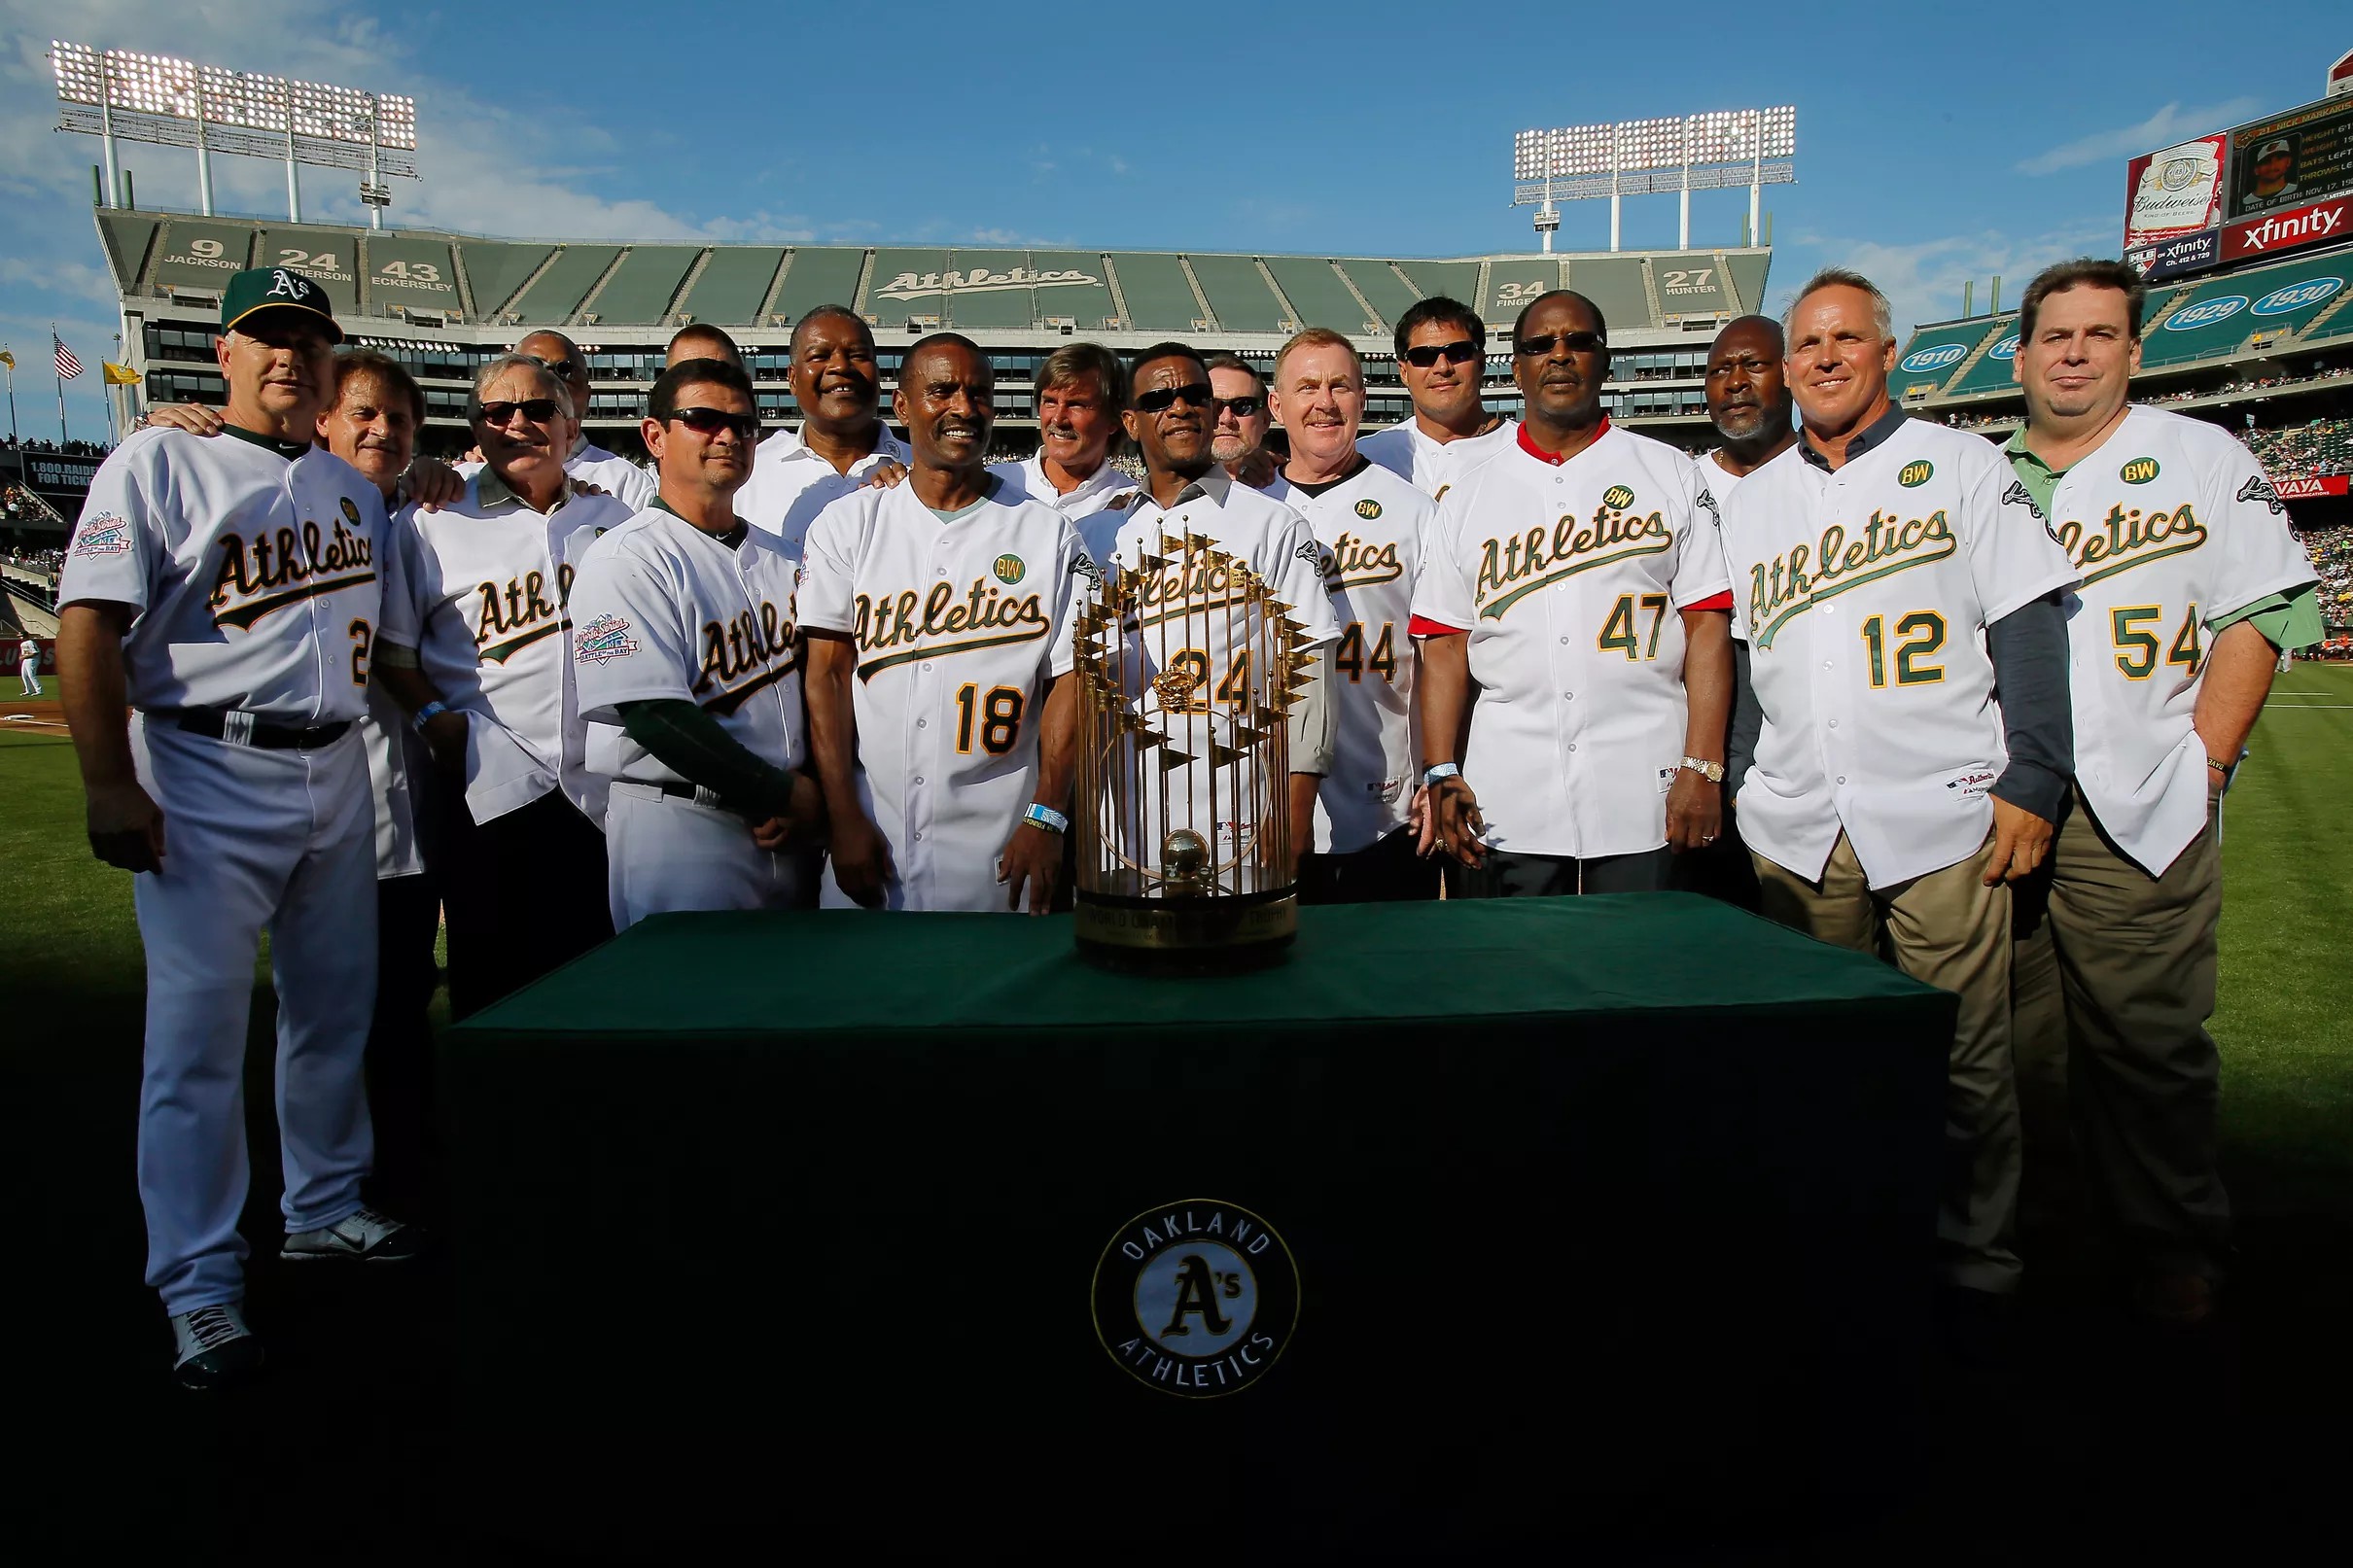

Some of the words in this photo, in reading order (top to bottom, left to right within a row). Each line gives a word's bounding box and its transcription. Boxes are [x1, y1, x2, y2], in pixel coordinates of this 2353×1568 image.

[2276, 119, 2300, 130] NICK
[2301, 101, 2352, 123] MARKAKIS
[2301, 128, 2335, 142] HEIGHT
[2301, 140, 2337, 155] WEIGHT
[2344, 135, 2353, 144] 19
[2300, 157, 2325, 169] BATS
[2329, 148, 2353, 160] LEFT
[2300, 165, 2340, 182] THROWS
[2341, 161, 2353, 170] LE
[2133, 193, 2212, 212] Budweiser
[2245, 200, 2265, 212] DATE
[2279, 192, 2302, 203] BIRTH
[2243, 207, 2343, 249] xfinity
[191, 240, 225, 259] 9
[279, 249, 339, 271] 24
[2130, 250, 2155, 263] MLB
[2166, 237, 2212, 258] xfinity
[2197, 251, 2210, 260] 729
[164, 255, 241, 270] JACKSON
[381, 261, 440, 282] 43
[265, 269, 310, 299] A's
[371, 276, 453, 292] ECKERSLEY
[875, 267, 1098, 294] Athletics
[1663, 268, 1713, 288] 27
[1498, 281, 1546, 299] 34
[1666, 285, 1716, 296] HUNTER
[2264, 283, 2334, 309] 1930
[1496, 297, 1535, 307] FINGE
[2174, 301, 2239, 325] 1929
[1909, 348, 1962, 367] 1910
[1997, 339, 2019, 355] 19
[31, 462, 98, 475] 1.800.RAIDE
[38, 473, 58, 484] FOR
[1901, 462, 1929, 485] BW
[2125, 461, 2155, 482] BW
[1604, 487, 1633, 507] BW
[2275, 478, 2323, 495] VAYA
[2287, 490, 2330, 499] COMMUNICATIONS
[1356, 501, 1380, 517] BW
[2056, 502, 2207, 571] letics
[204, 517, 372, 610] Athletic
[1320, 530, 1404, 579] etics
[1475, 504, 1673, 607] Athletics
[997, 556, 1021, 580] BW
[1750, 507, 1956, 637] Athletics
[854, 575, 1050, 652] Athletics
[599, 617, 626, 637] Series
[1597, 592, 1670, 662] 47
[1336, 621, 1396, 683] 44
[1860, 610, 1948, 689] 12
[2108, 602, 2202, 681] 54
[580, 650, 601, 661] BATTLE
[955, 681, 1026, 756] 18
[2208, 758, 2224, 770] DAVE
[1122, 1211, 1270, 1261] OAKLAND
[1159, 1254, 1244, 1339] A's
[1118, 1332, 1274, 1388] ATHLETICS
